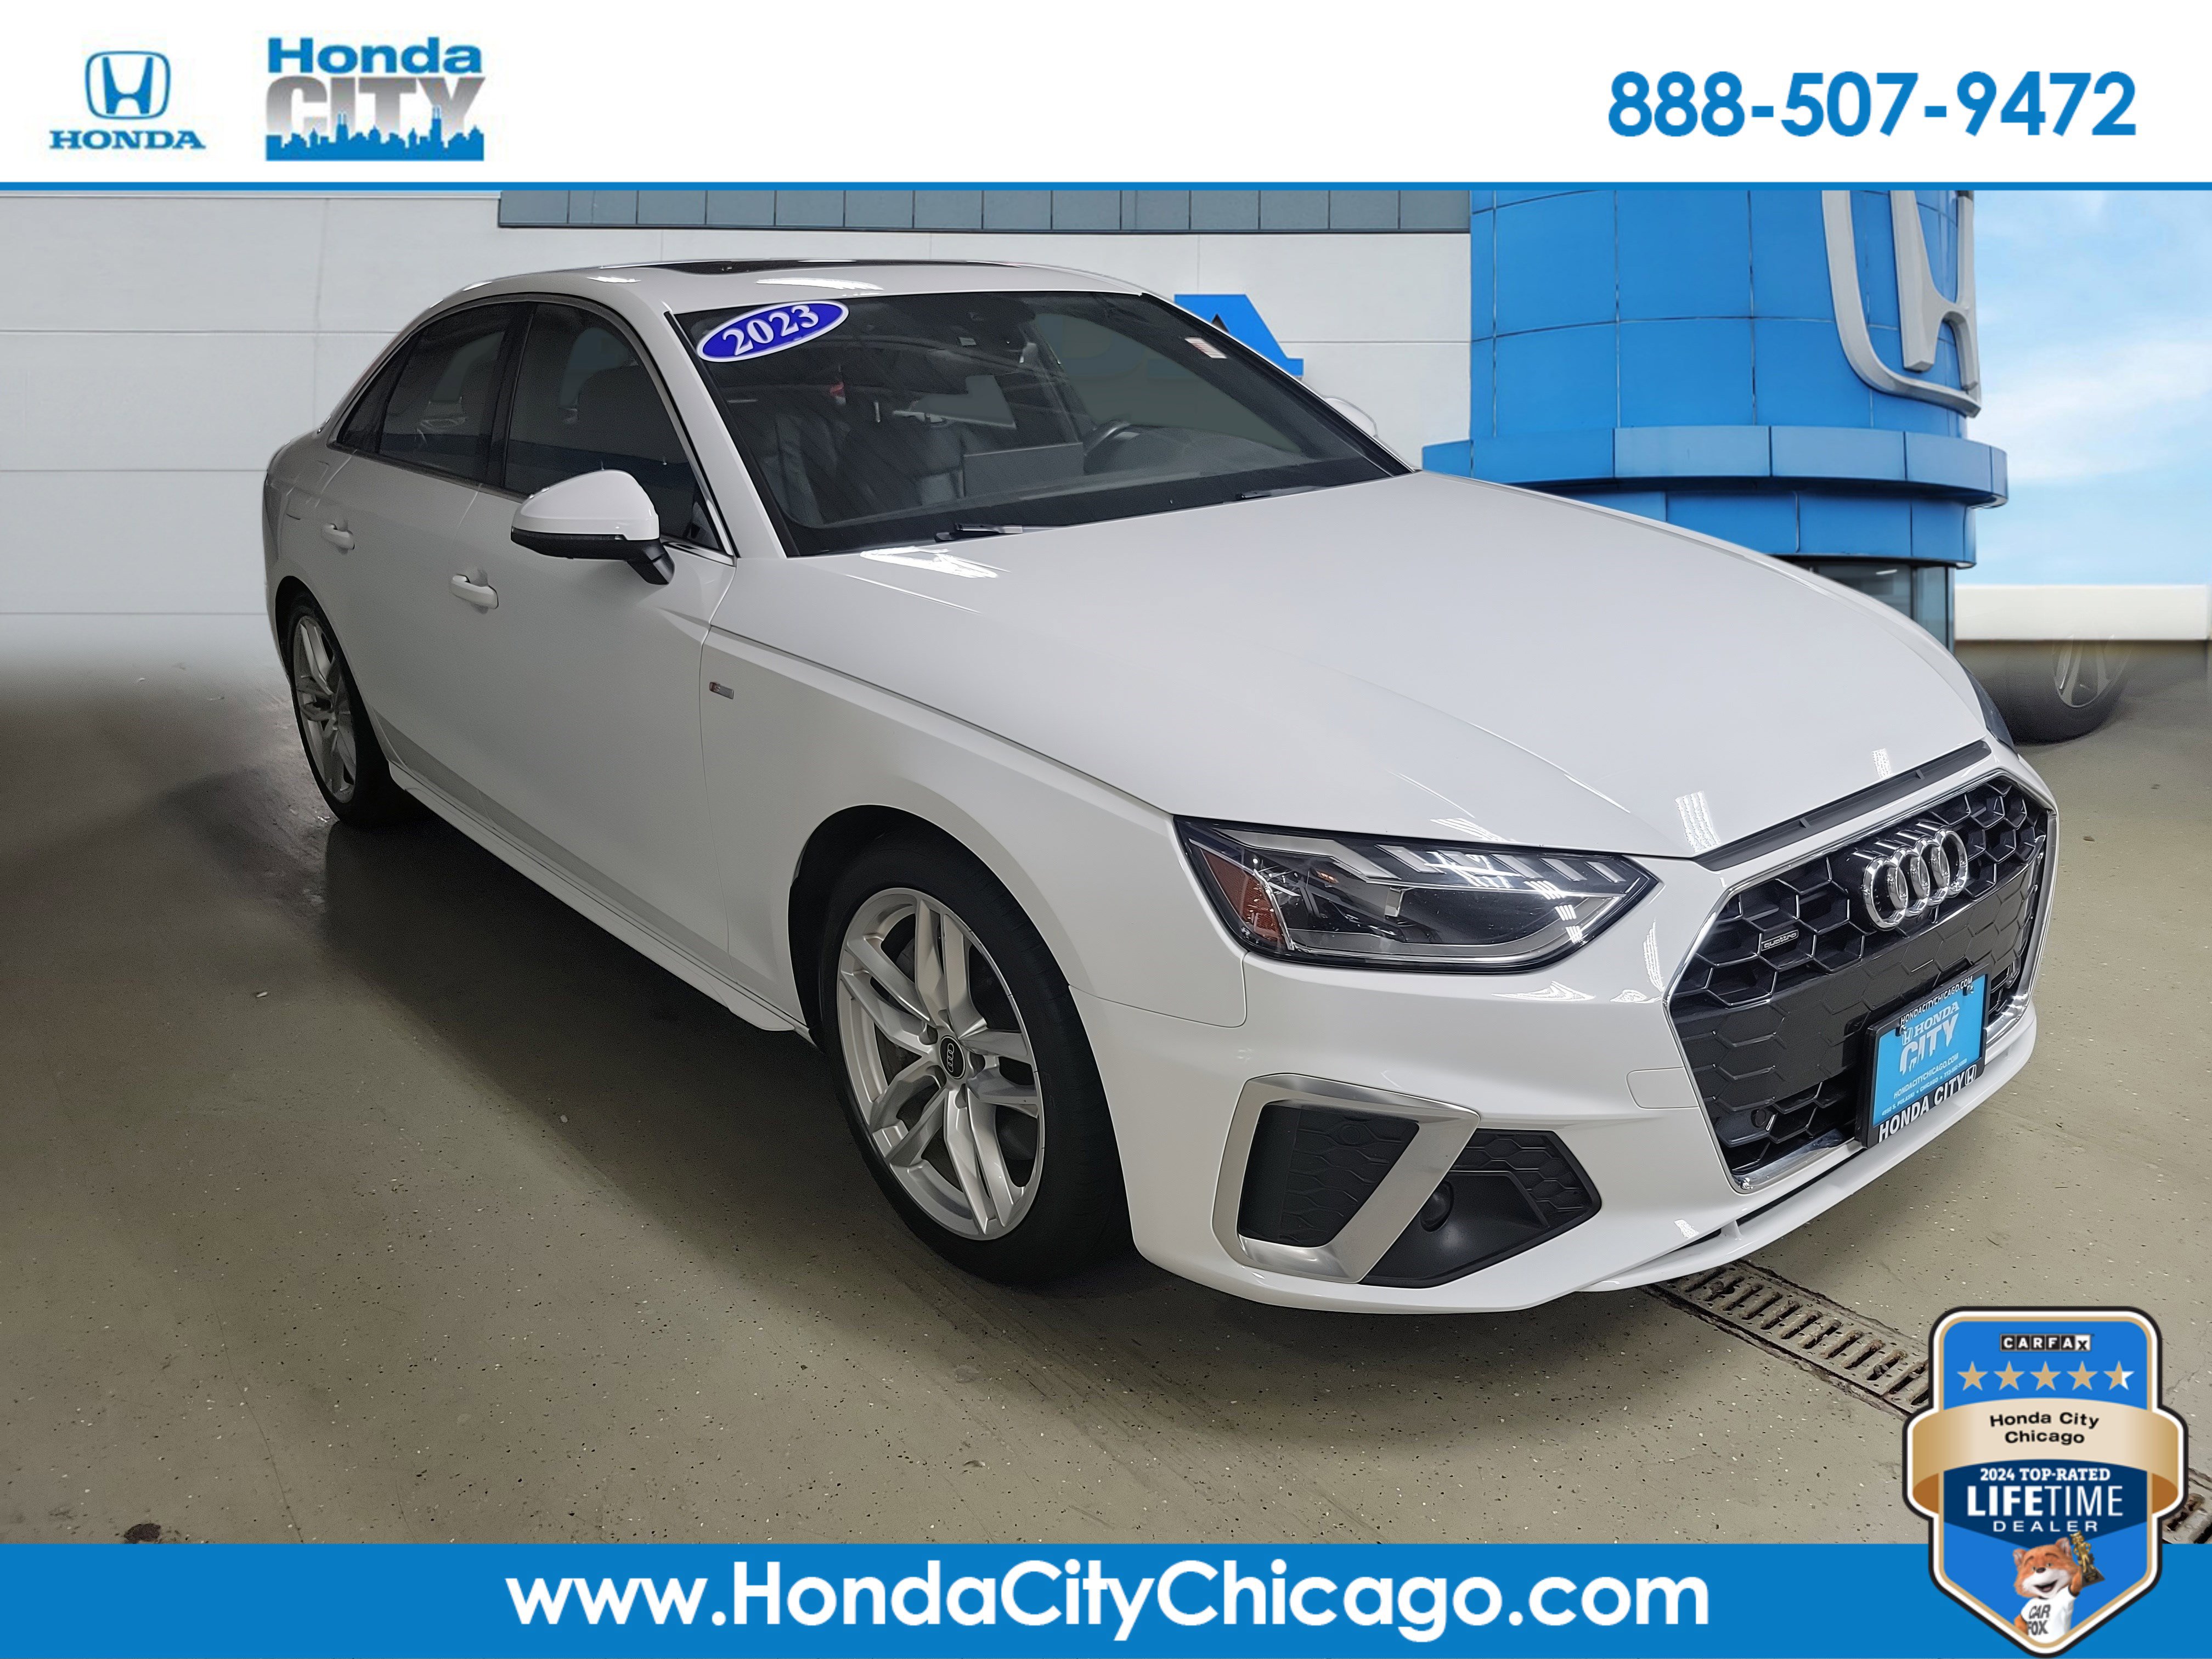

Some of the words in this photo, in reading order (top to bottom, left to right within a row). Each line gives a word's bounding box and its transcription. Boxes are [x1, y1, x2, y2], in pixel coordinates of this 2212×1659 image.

[723, 305, 819, 356] 2023
[1764, 933, 1797, 949] quattro
[1900, 976, 1973, 1025] HONDACITYCHICAGO.COM
[1914, 1001, 1960, 1037] HONDA
[1899, 1013, 1959, 1075] CITY
[1894, 1052, 1959, 1099] HONDACITYCHICAGO.COM
[1879, 1095, 1929, 1143] HONDA
[1934, 1071, 1965, 1105] CITY
